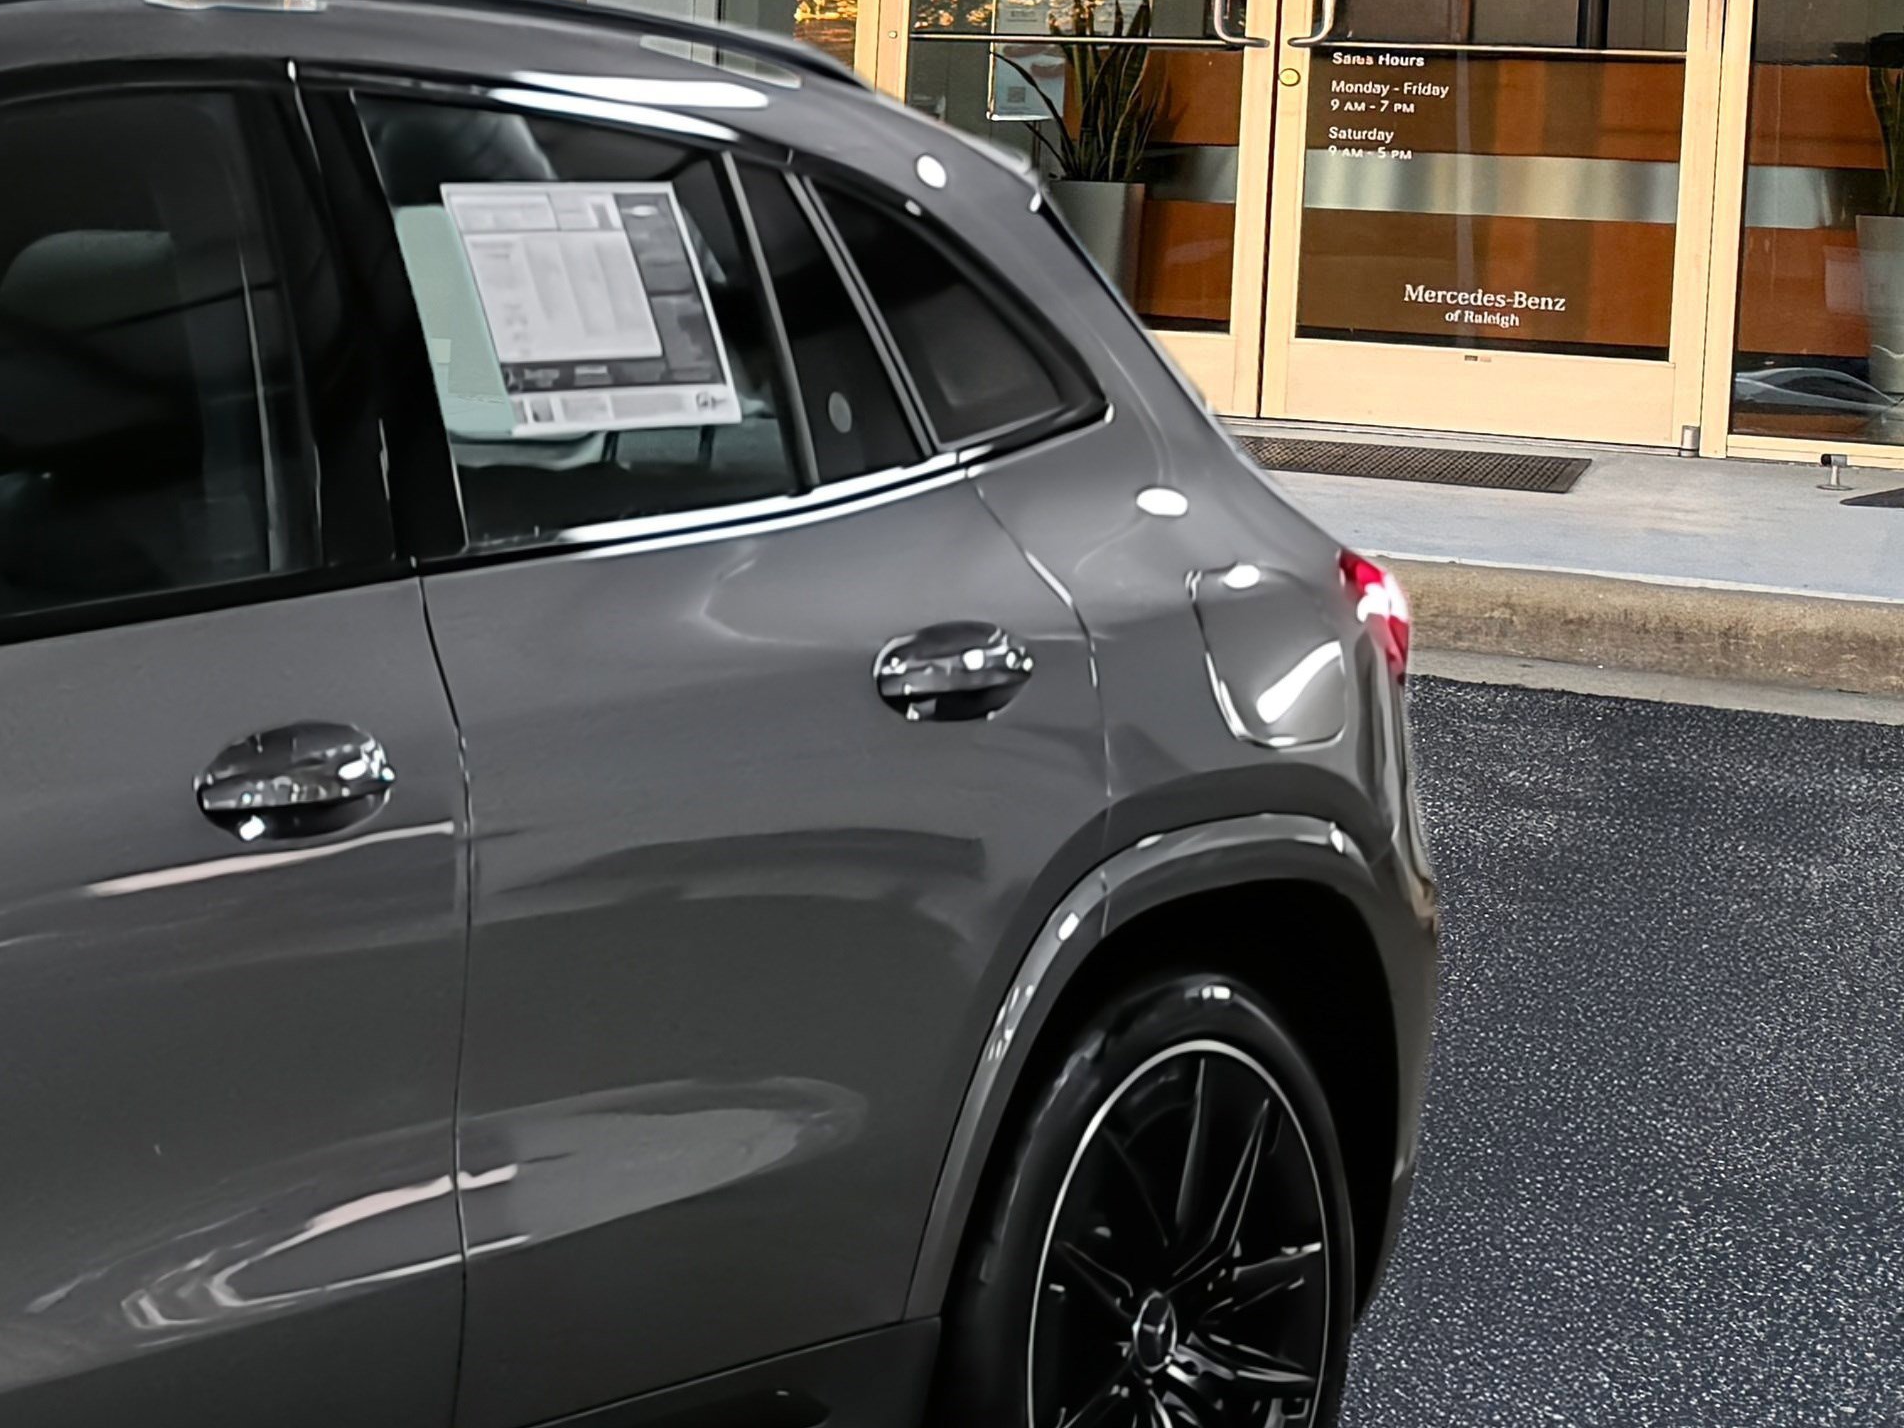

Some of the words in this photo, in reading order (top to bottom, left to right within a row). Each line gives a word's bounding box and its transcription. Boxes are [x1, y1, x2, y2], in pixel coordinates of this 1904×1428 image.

[1378, 53, 1425, 67] Hours
[1331, 80, 1390, 97] Monday
[1403, 82, 1450, 99] Friday
[1330, 98, 1340, 111] 9
[1343, 101, 1366, 112] AM
[1379, 99, 1389, 112] 7
[1393, 103, 1415, 113] PM
[1328, 126, 1395, 144] Saturday
[1328, 145, 1337, 157] 9
[1341, 147, 1364, 158] AM
[1377, 146, 1386, 159] 5
[1391, 149, 1412, 160] PM
[1403, 283, 1566, 312] Mercedes-Benz
[1444, 309, 1461, 323] of
[1464, 310, 1520, 329] Raleigh
